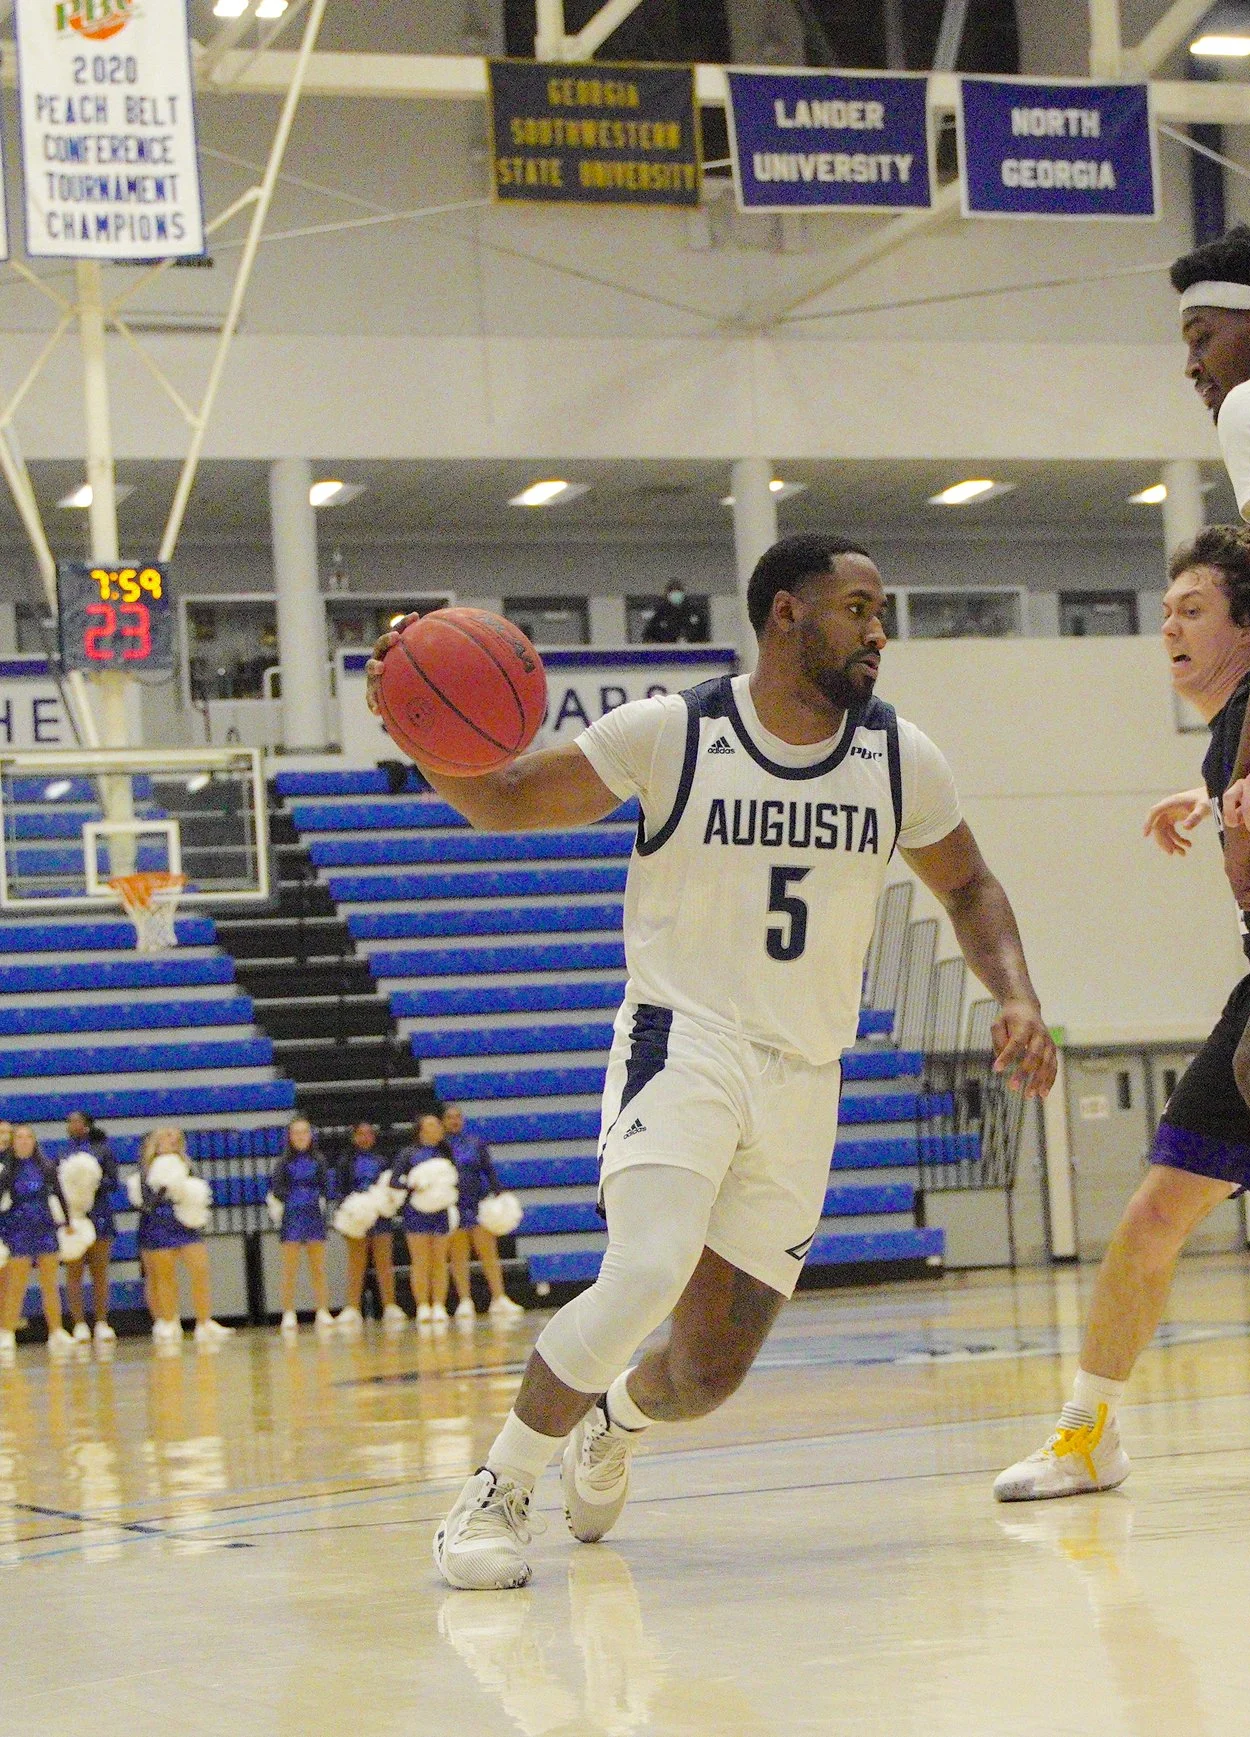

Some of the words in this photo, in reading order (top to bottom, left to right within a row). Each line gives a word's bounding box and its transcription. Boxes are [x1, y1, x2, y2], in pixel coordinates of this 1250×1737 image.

[73, 55, 138, 85] 2020
[35, 93, 108, 124] PEACH
[125, 95, 178, 127] BELT
[774, 98, 885, 130] LANDER
[1010, 107, 1100, 139] NORTH
[43, 133, 175, 165] CONFERENCE
[753, 151, 914, 184] UNIVERSITY
[1001, 158, 1117, 190] GEORGIA
[45, 172, 178, 203] TOURNAMENT
[46, 211, 186, 243] CHAMPIONS
[90, 567, 164, 603] 7:59
[84, 601, 153, 661] 23
[706, 747, 736, 755] adidas
[850, 745, 883, 761] PBC
[703, 798, 880, 855] AUGUSTA
[765, 863, 816, 963] 5
